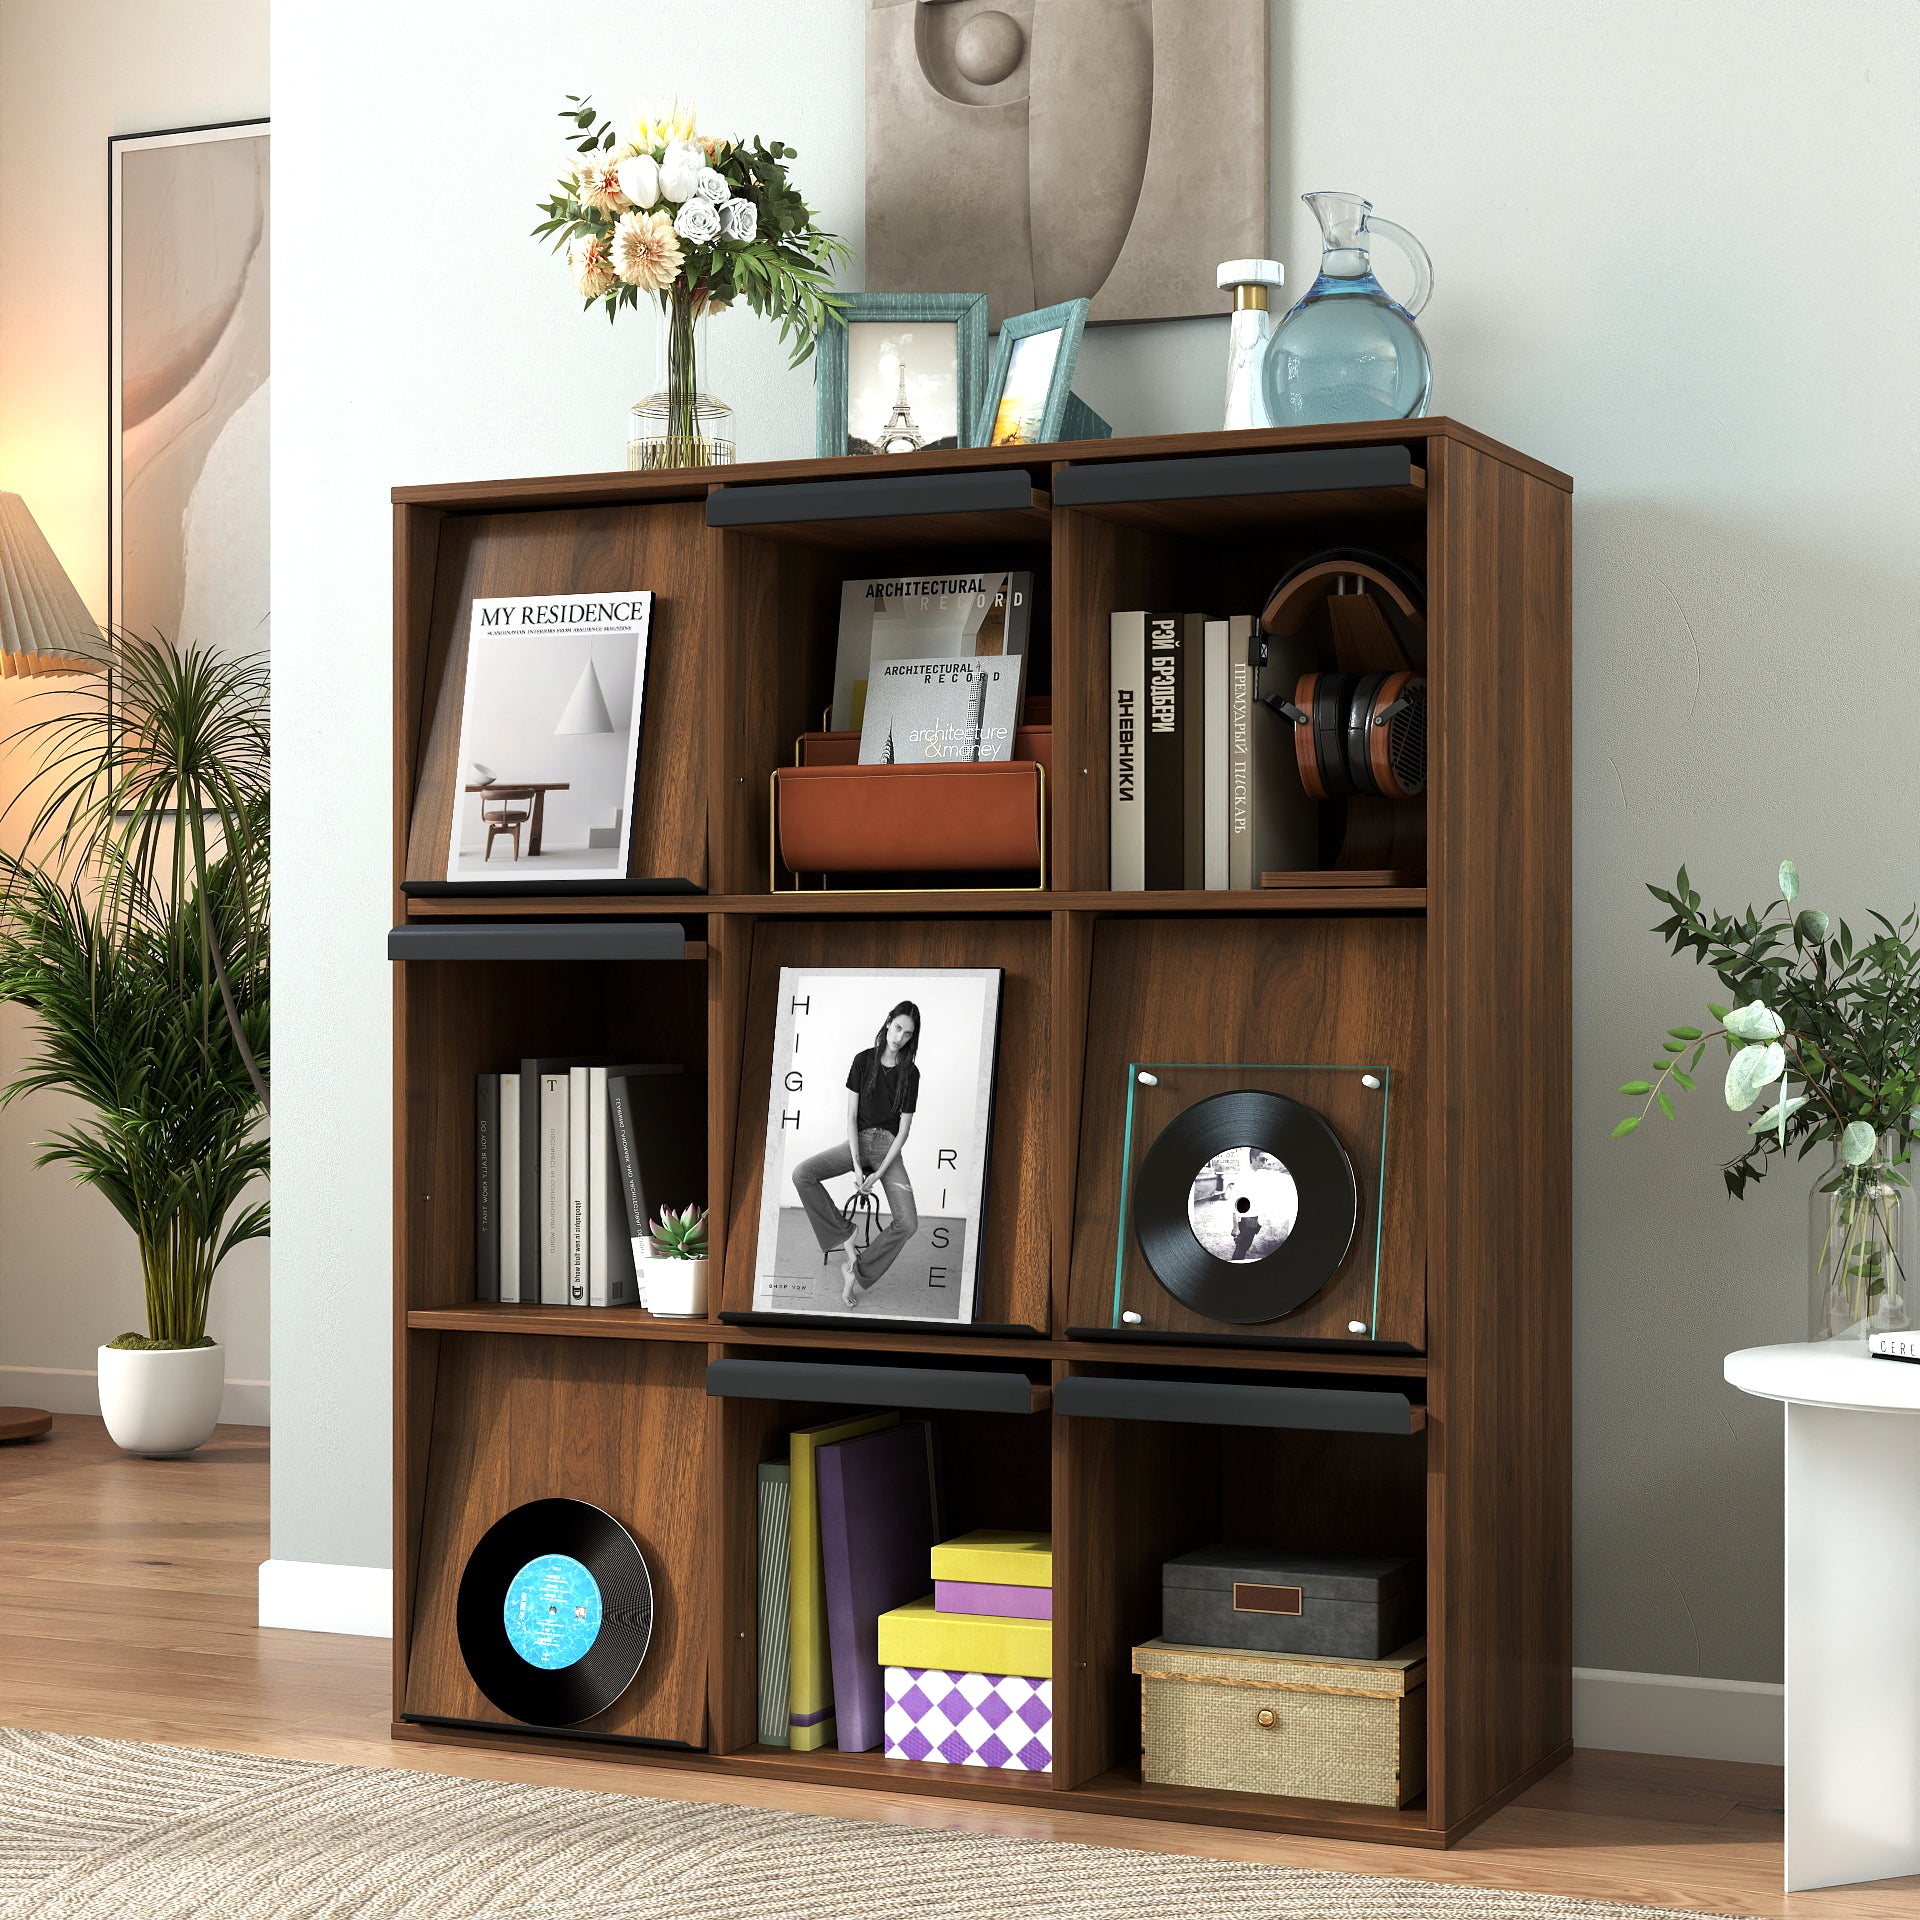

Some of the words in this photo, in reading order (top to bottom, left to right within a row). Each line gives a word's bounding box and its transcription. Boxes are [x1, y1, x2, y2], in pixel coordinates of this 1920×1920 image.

[866, 579, 986, 598] ARCHITECTURAL
[920, 592, 1023, 610] RECORD
[480, 607, 515, 626] MY
[521, 602, 643, 625] RESIDENCE
[1151, 620, 1181, 650] РЭЙ
[884, 663, 973, 676] ARCHITECTURAL
[924, 672, 1000, 684] RECORD
[1151, 656, 1175, 733] БРЭДБЕРИ
[1233, 663, 1248, 754] ПРЕМУДРЫЙ
[909, 717, 1007, 742] architecture
[1118, 689, 1134, 802] ДНЕВНИКИ
[1234, 762, 1246, 834] ПИСКАРЬ
[547, 1080, 557, 1091] T
